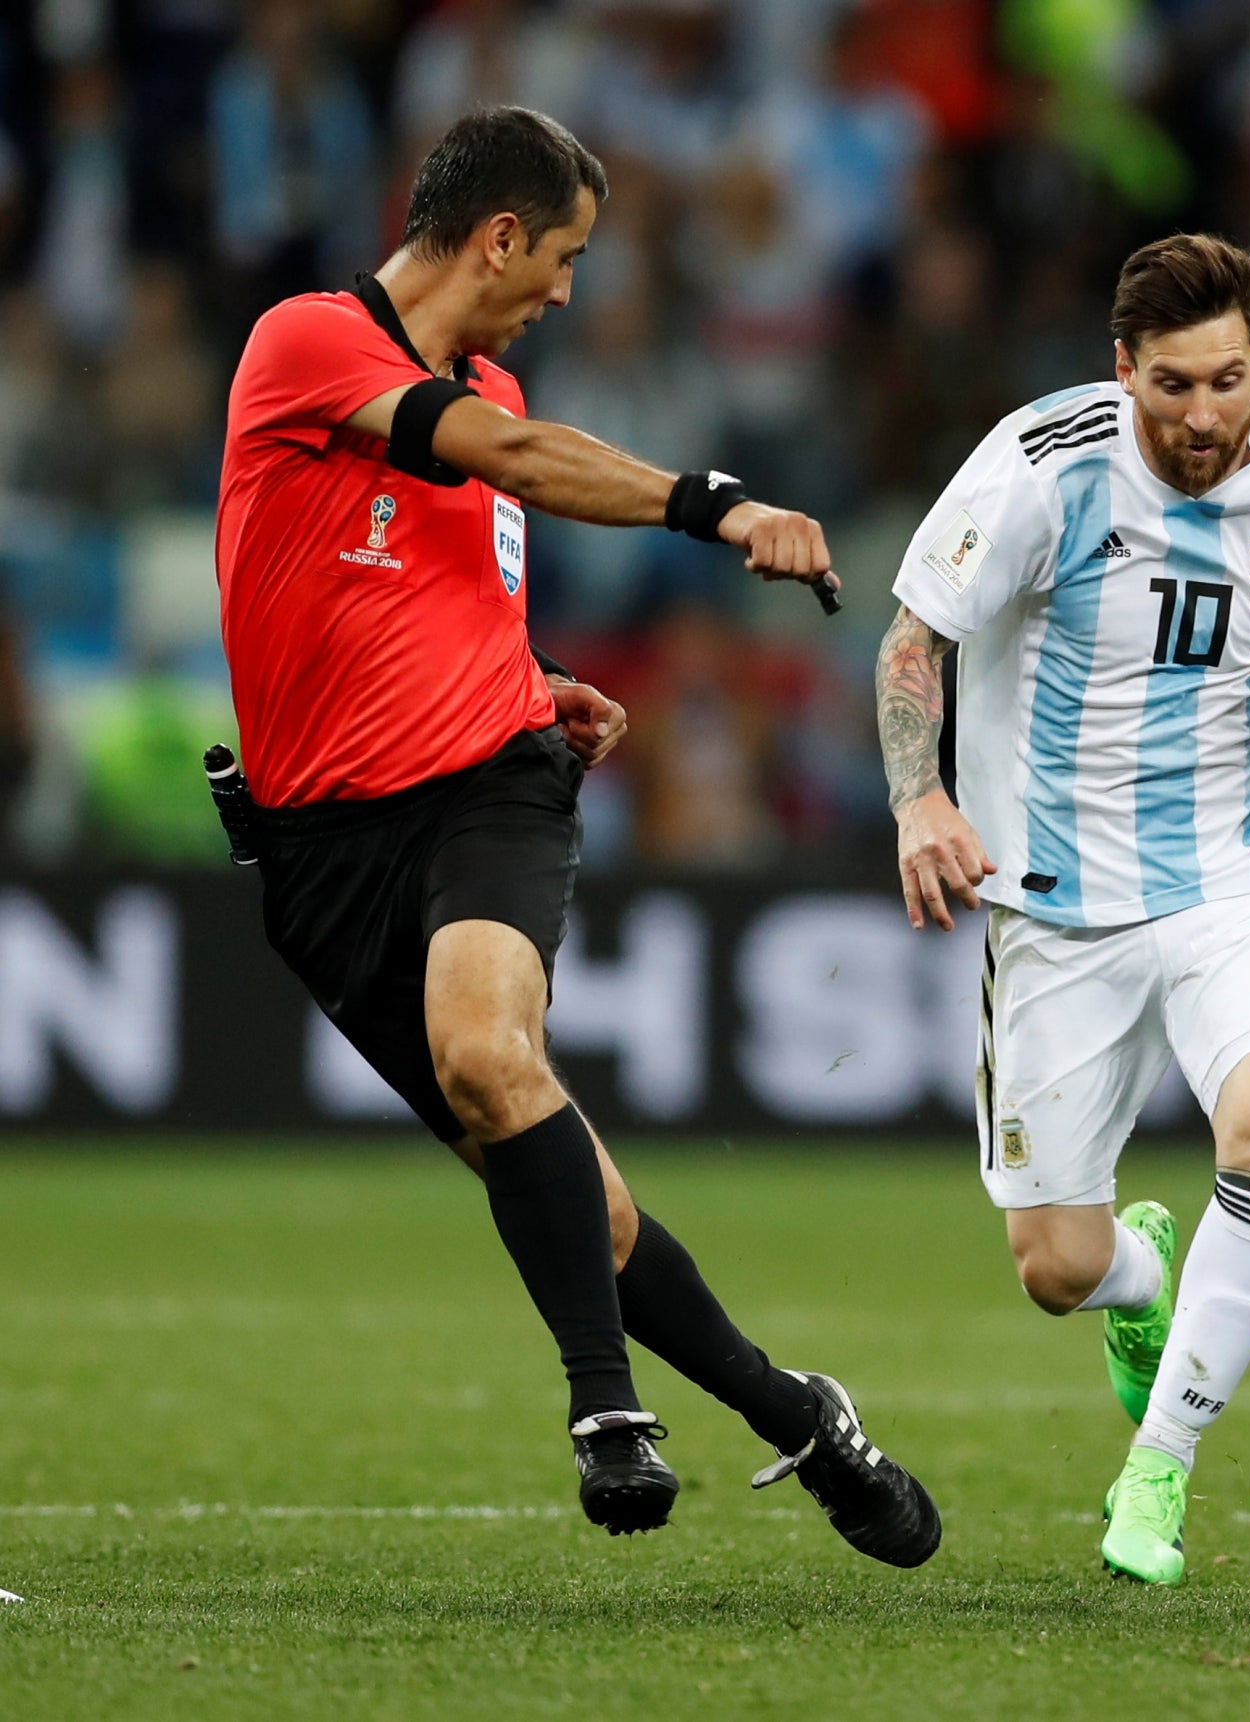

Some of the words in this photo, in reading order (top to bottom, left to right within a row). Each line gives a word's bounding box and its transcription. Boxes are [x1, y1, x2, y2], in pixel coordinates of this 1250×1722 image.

[339, 550, 378, 566] RUSSIA
[378, 557, 403, 570] 2018
[499, 531, 521, 563] FIFA
[927, 552, 952, 578] RUSSIA
[1149, 577, 1234, 667] 10
